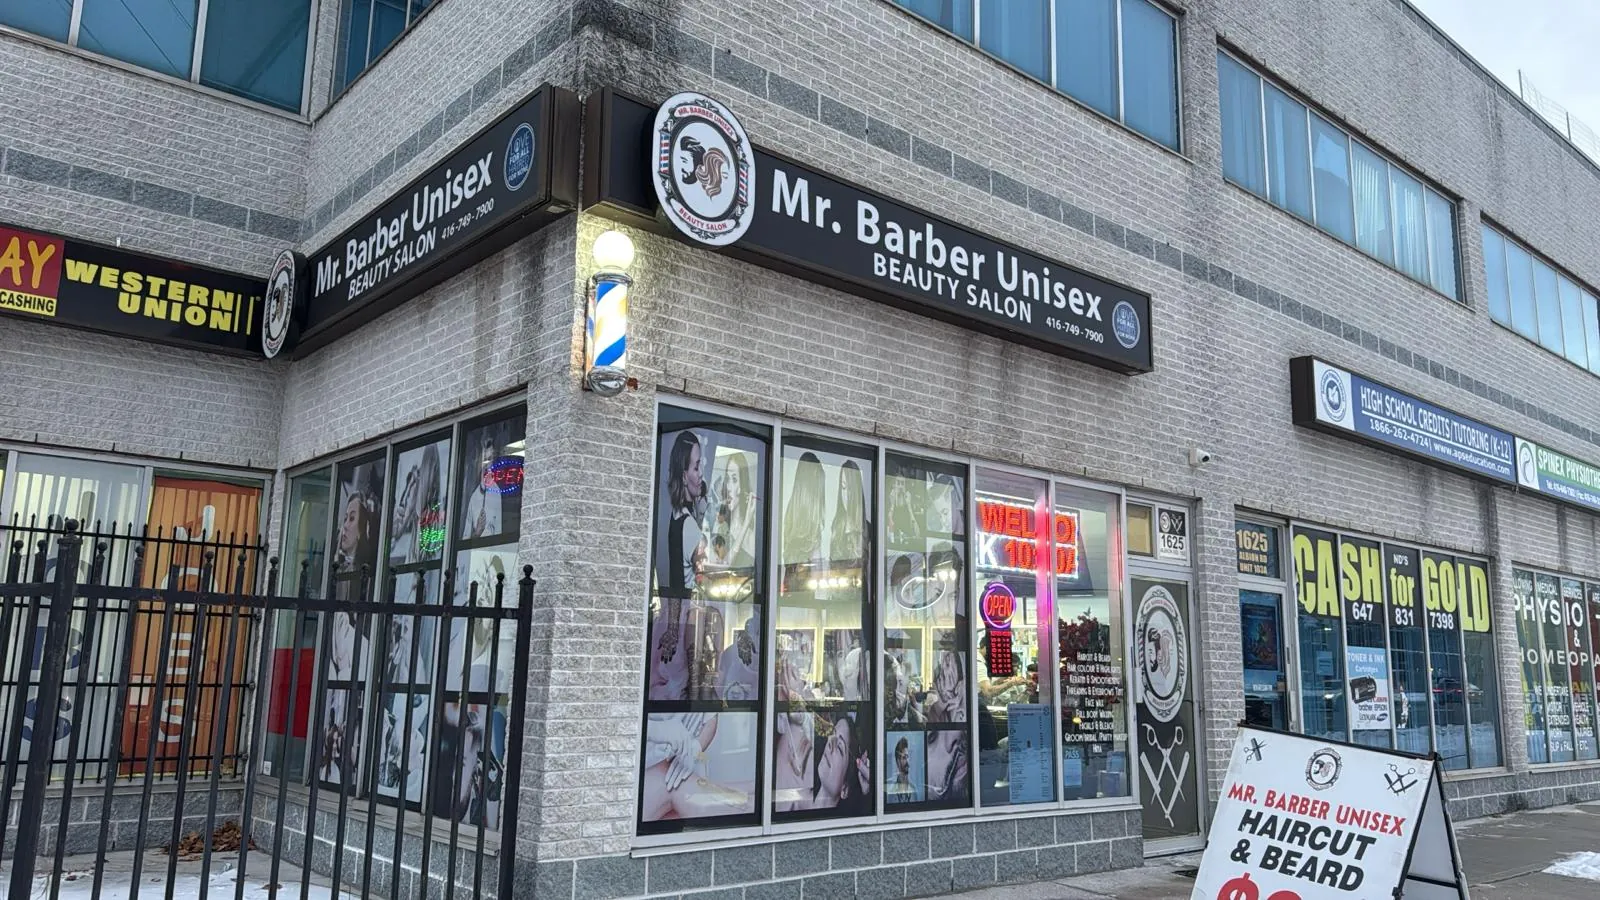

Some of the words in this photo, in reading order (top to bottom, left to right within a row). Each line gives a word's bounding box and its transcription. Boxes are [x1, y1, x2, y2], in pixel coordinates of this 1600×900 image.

[315, 255, 341, 298] Mr.
[345, 208, 408, 279] Barber
[412, 151, 493, 232] Unisex
[679, 208, 705, 229] BEAUTY
[706, 222, 728, 232] SALON
[348, 258, 393, 300] BEAUTY
[393, 227, 436, 269] SALON
[441, 197, 494, 240] 416-749-7900
[771, 168, 842, 234] Mr.
[857, 199, 985, 281] Barber
[996, 250, 1103, 322] Unisex
[0, 291, 54, 312] CASHING
[65, 259, 235, 312] WESTERN
[873, 252, 960, 300] BEAUTY
[966, 284, 1032, 324] SALON
[1045, 316, 1104, 344] 416-749-7900
[118, 291, 232, 332] UNION
[1360, 385, 1383, 414] HIGH
[1385, 395, 1417, 426] SCHOOL
[1537, 448, 1565, 478] SPINEX
[1161, 534, 1185, 551] 1625
[1237, 529, 1268, 552] 1625
[1294, 534, 1383, 616] CASH
[1390, 567, 1415, 608] for
[1423, 557, 1490, 632] GOLD
[987, 594, 1012, 617] OPEN
[1352, 602, 1373, 621] 647
[1395, 607, 1414, 626] 831
[1429, 612, 1454, 630] 7398
[1573, 629, 1581, 648] &
[1227, 782, 1257, 805] MR.
[1264, 789, 1330, 820] BARBER
[1335, 805, 1406, 837] UNISEX
[1238, 809, 1376, 861] HAIRCUT
[1230, 838, 1251, 865] &
[1259, 845, 1364, 892] BEARD
